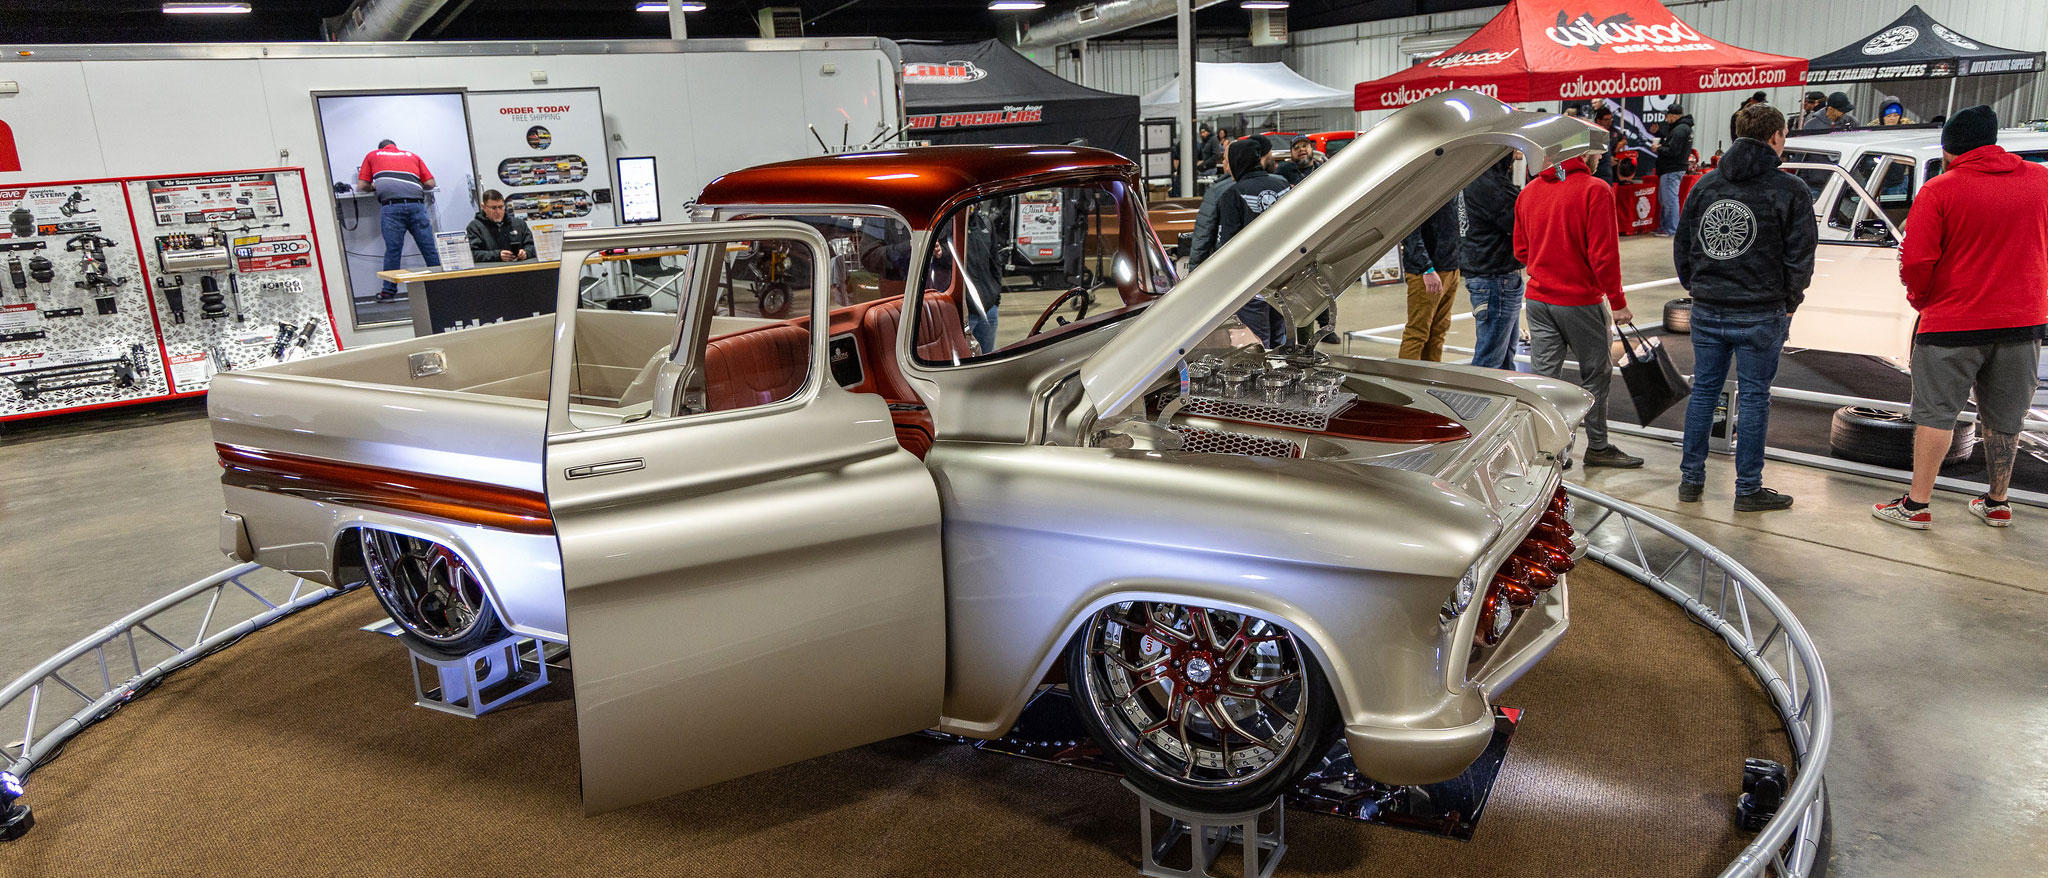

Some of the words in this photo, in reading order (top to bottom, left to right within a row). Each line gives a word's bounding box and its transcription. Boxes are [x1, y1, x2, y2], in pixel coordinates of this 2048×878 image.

[1546, 15, 1700, 47] wilwood
[1612, 43, 1654, 54] DISC
[1653, 43, 1716, 53] BRAKES
[1428, 48, 1520, 67] wilwood
[2010, 57, 2034, 70] SUPPLIES
[1699, 66, 1786, 89] wilwood.com
[1807, 70, 1827, 82] UTO
[1827, 67, 1877, 81] DETAILING
[1876, 64, 1928, 79] SUPPLIES
[1560, 72, 1662, 98] wilwood.com
[499, 107, 534, 115] ORDER
[537, 105, 570, 113] TODAY
[529, 113, 561, 121] SHIPPING
[940, 110, 1042, 128] SPECIALTIES
[1643, 112, 1668, 122] IDID
[175, 178, 211, 186] Suspension
[0, 190, 21, 199] ave
